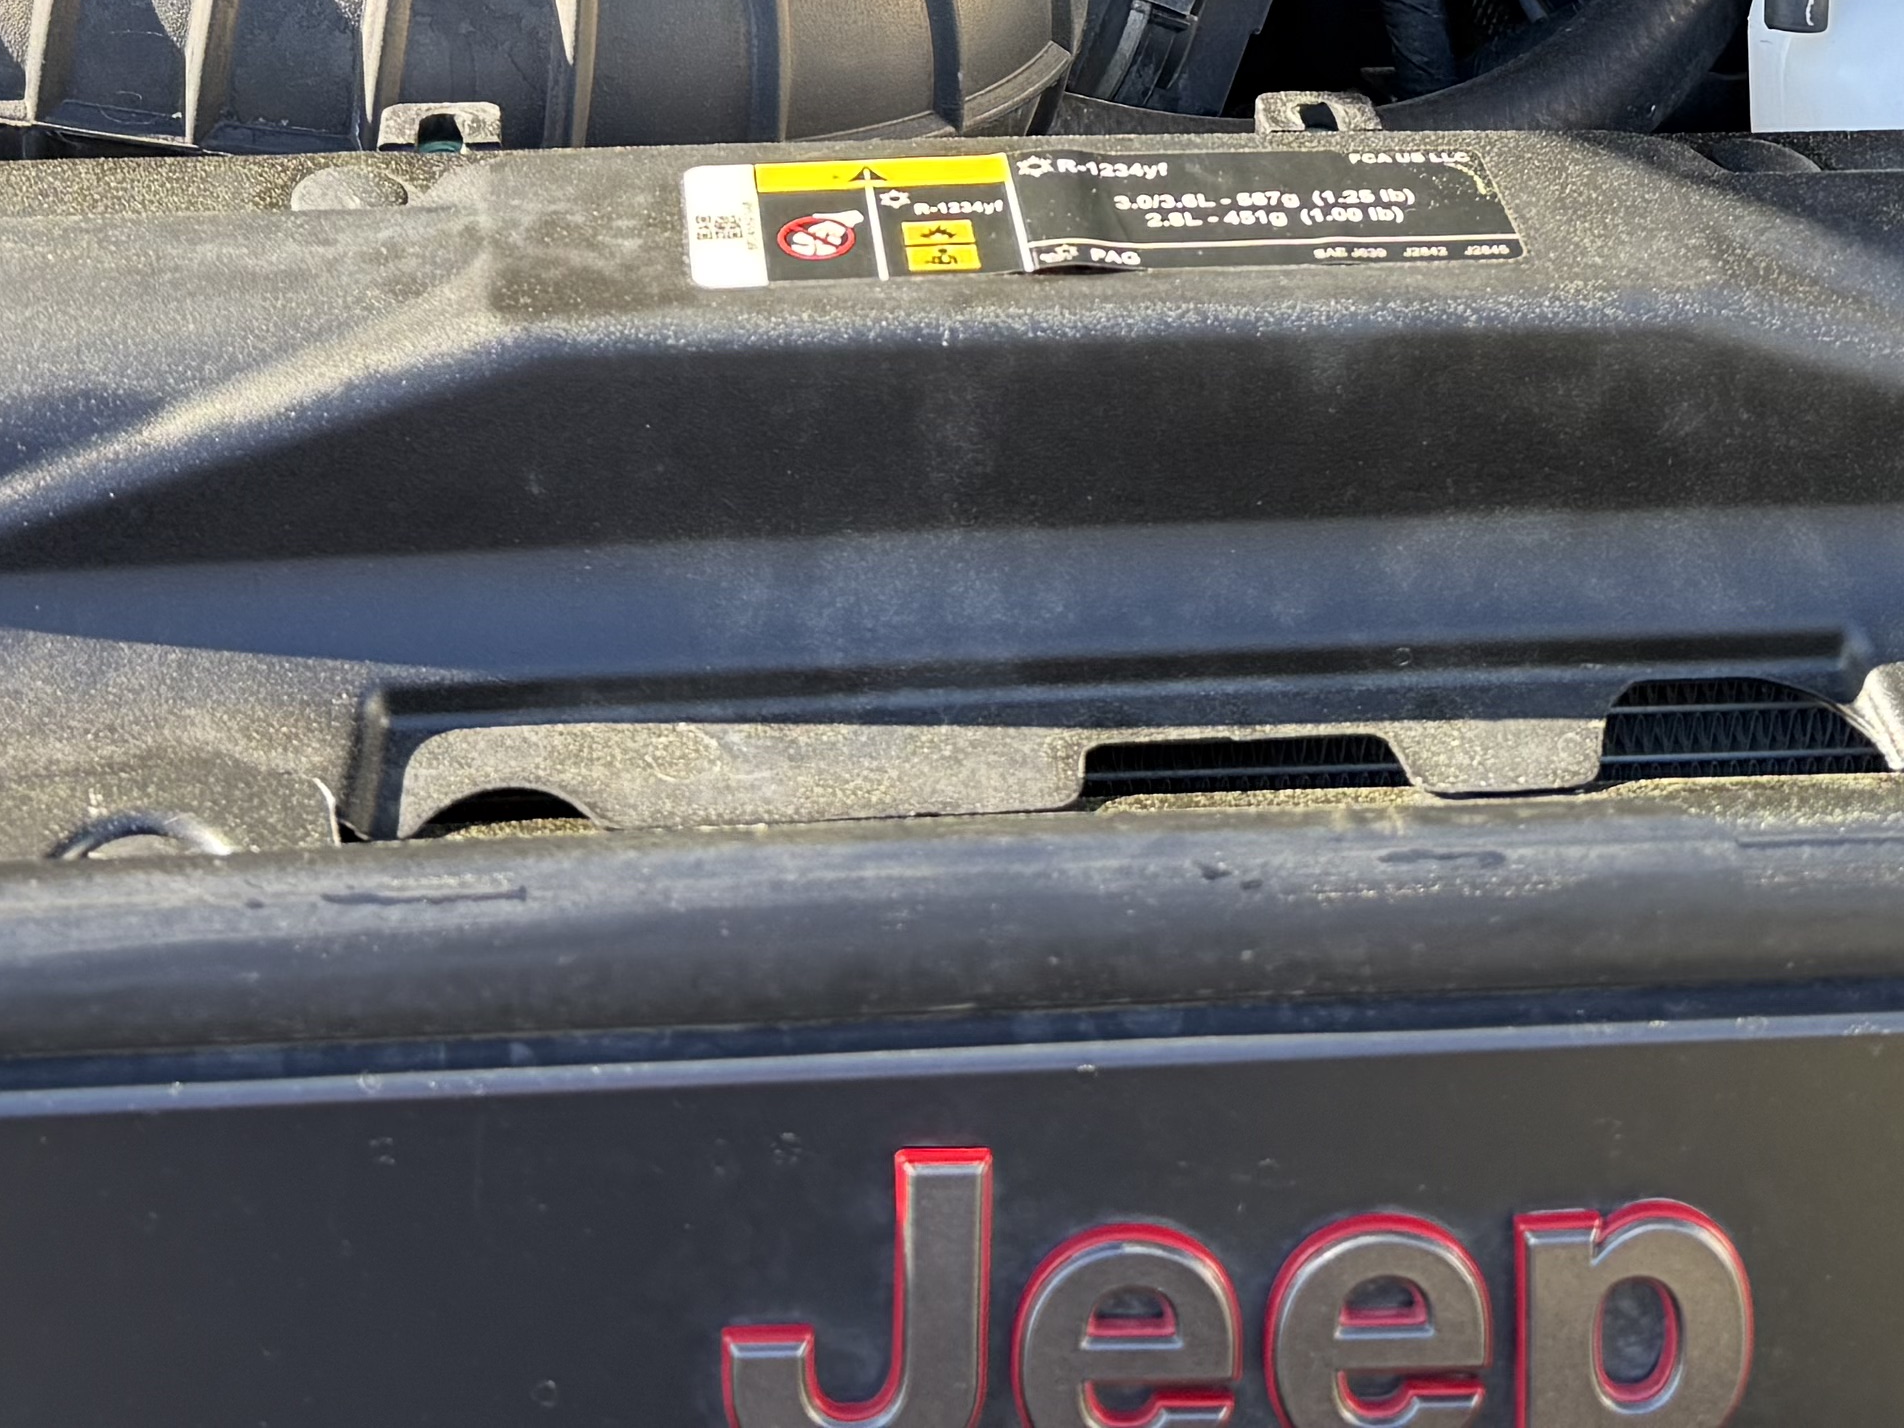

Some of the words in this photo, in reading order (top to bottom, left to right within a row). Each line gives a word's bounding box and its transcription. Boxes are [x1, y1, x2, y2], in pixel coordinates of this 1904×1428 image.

[1347, 152, 1393, 165] FCA
[1395, 151, 1426, 164] US
[1428, 150, 1472, 163] LLC
[1311, 188, 1377, 207] (1.25
[1378, 187, 1417, 207] lb)
[1299, 206, 1364, 226] (1.00
[1367, 205, 1406, 225] lb)
[1088, 248, 1142, 266] PAG
[720, 1145, 1755, 1428] Jeep
